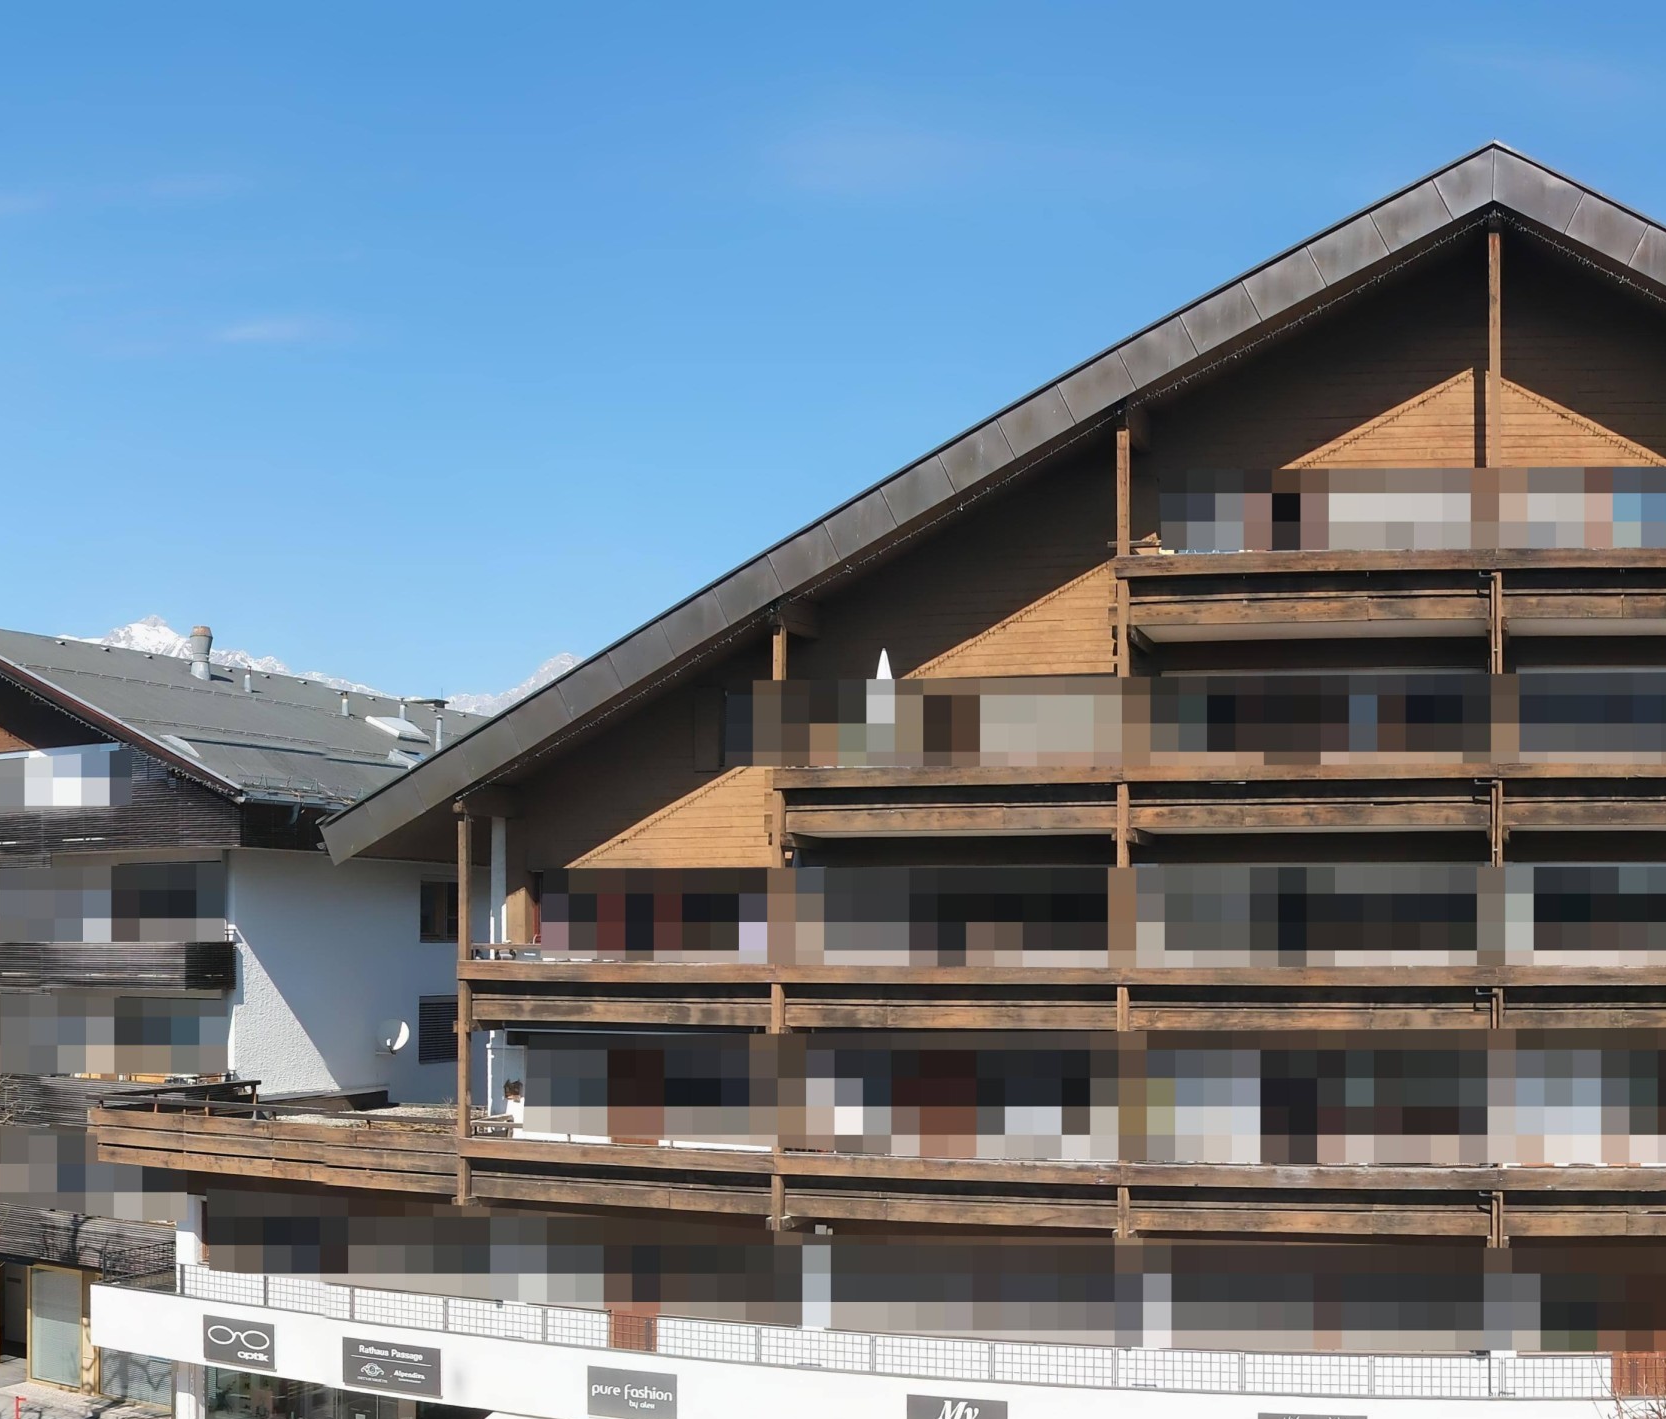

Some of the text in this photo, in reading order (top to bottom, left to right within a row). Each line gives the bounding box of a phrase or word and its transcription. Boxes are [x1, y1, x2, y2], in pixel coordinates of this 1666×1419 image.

[237, 1351, 269, 1362] optik
[358, 1344, 423, 1361] Rathaus Passage
[592, 1383, 673, 1402] pure fashion
[629, 1400, 638, 1409] by
